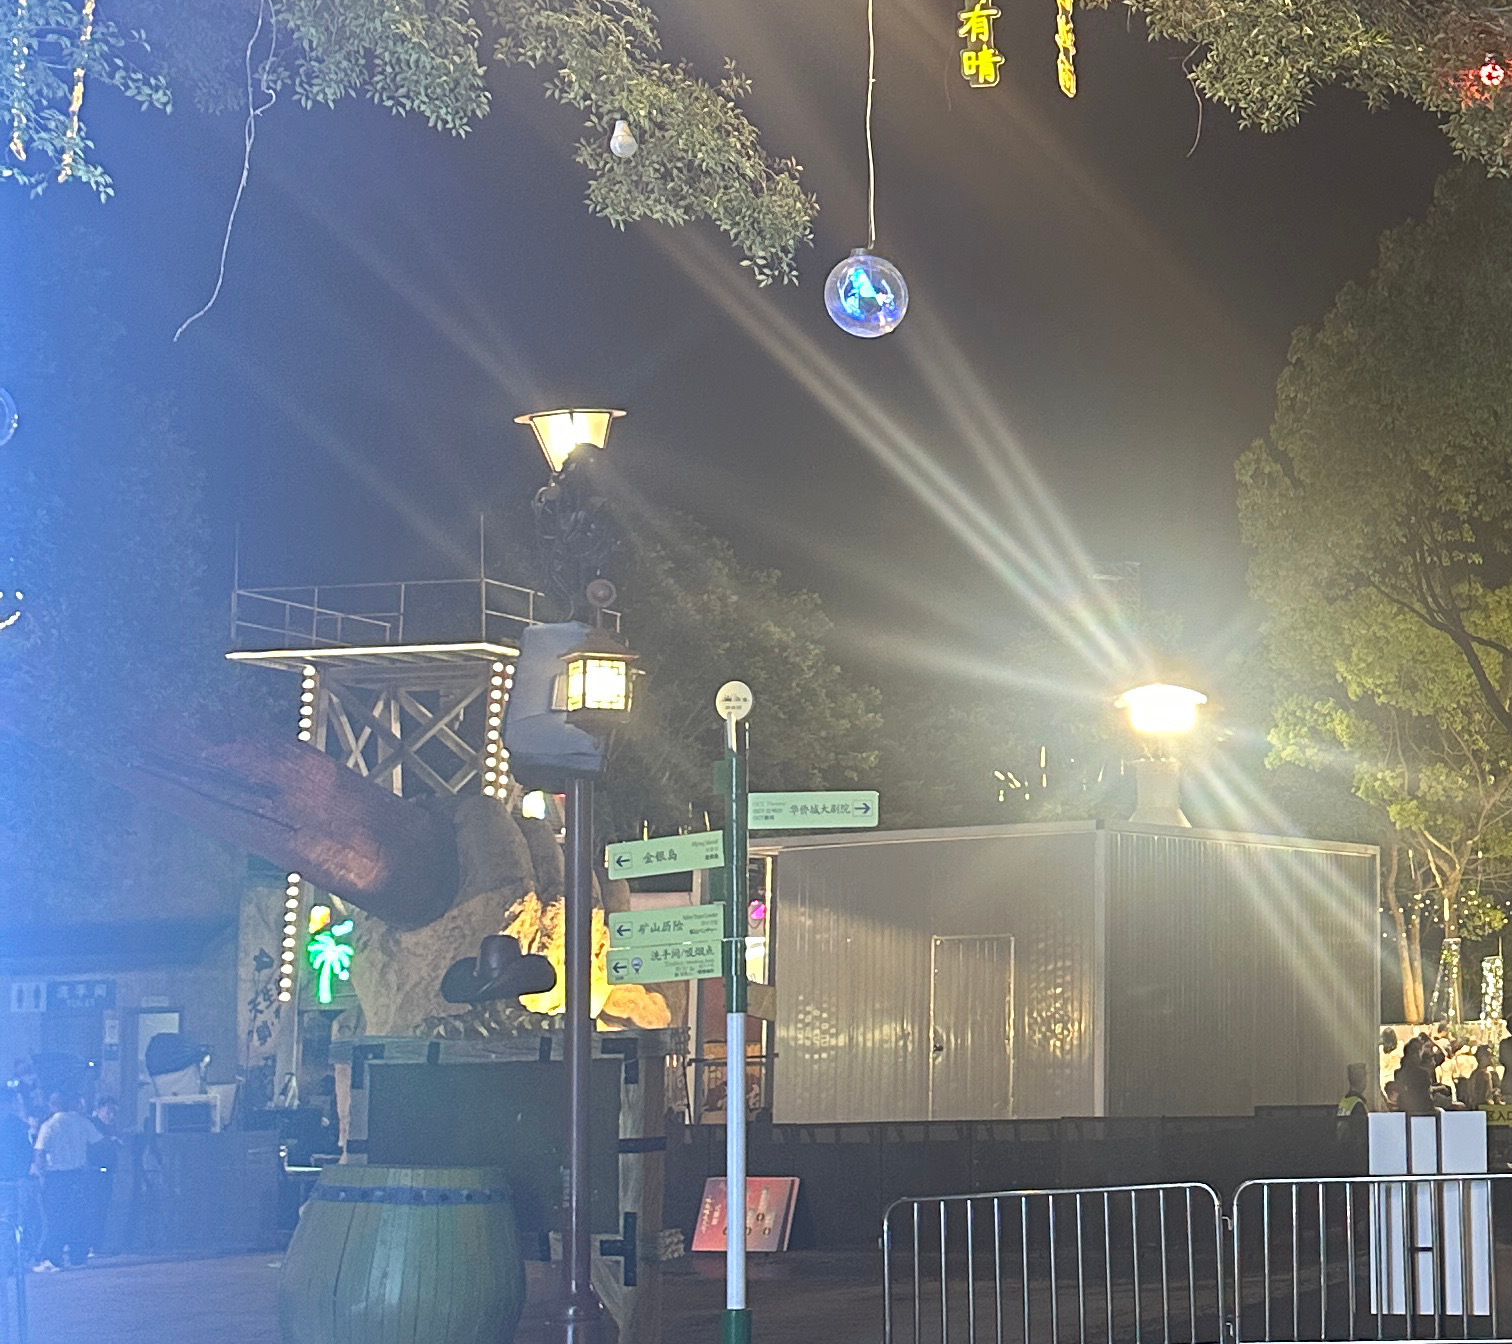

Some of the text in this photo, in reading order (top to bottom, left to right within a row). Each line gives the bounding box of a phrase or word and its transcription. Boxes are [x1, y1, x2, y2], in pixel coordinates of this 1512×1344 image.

[643, 848, 678, 864] 金银岛
[638, 920, 684, 935] 矿山历险
